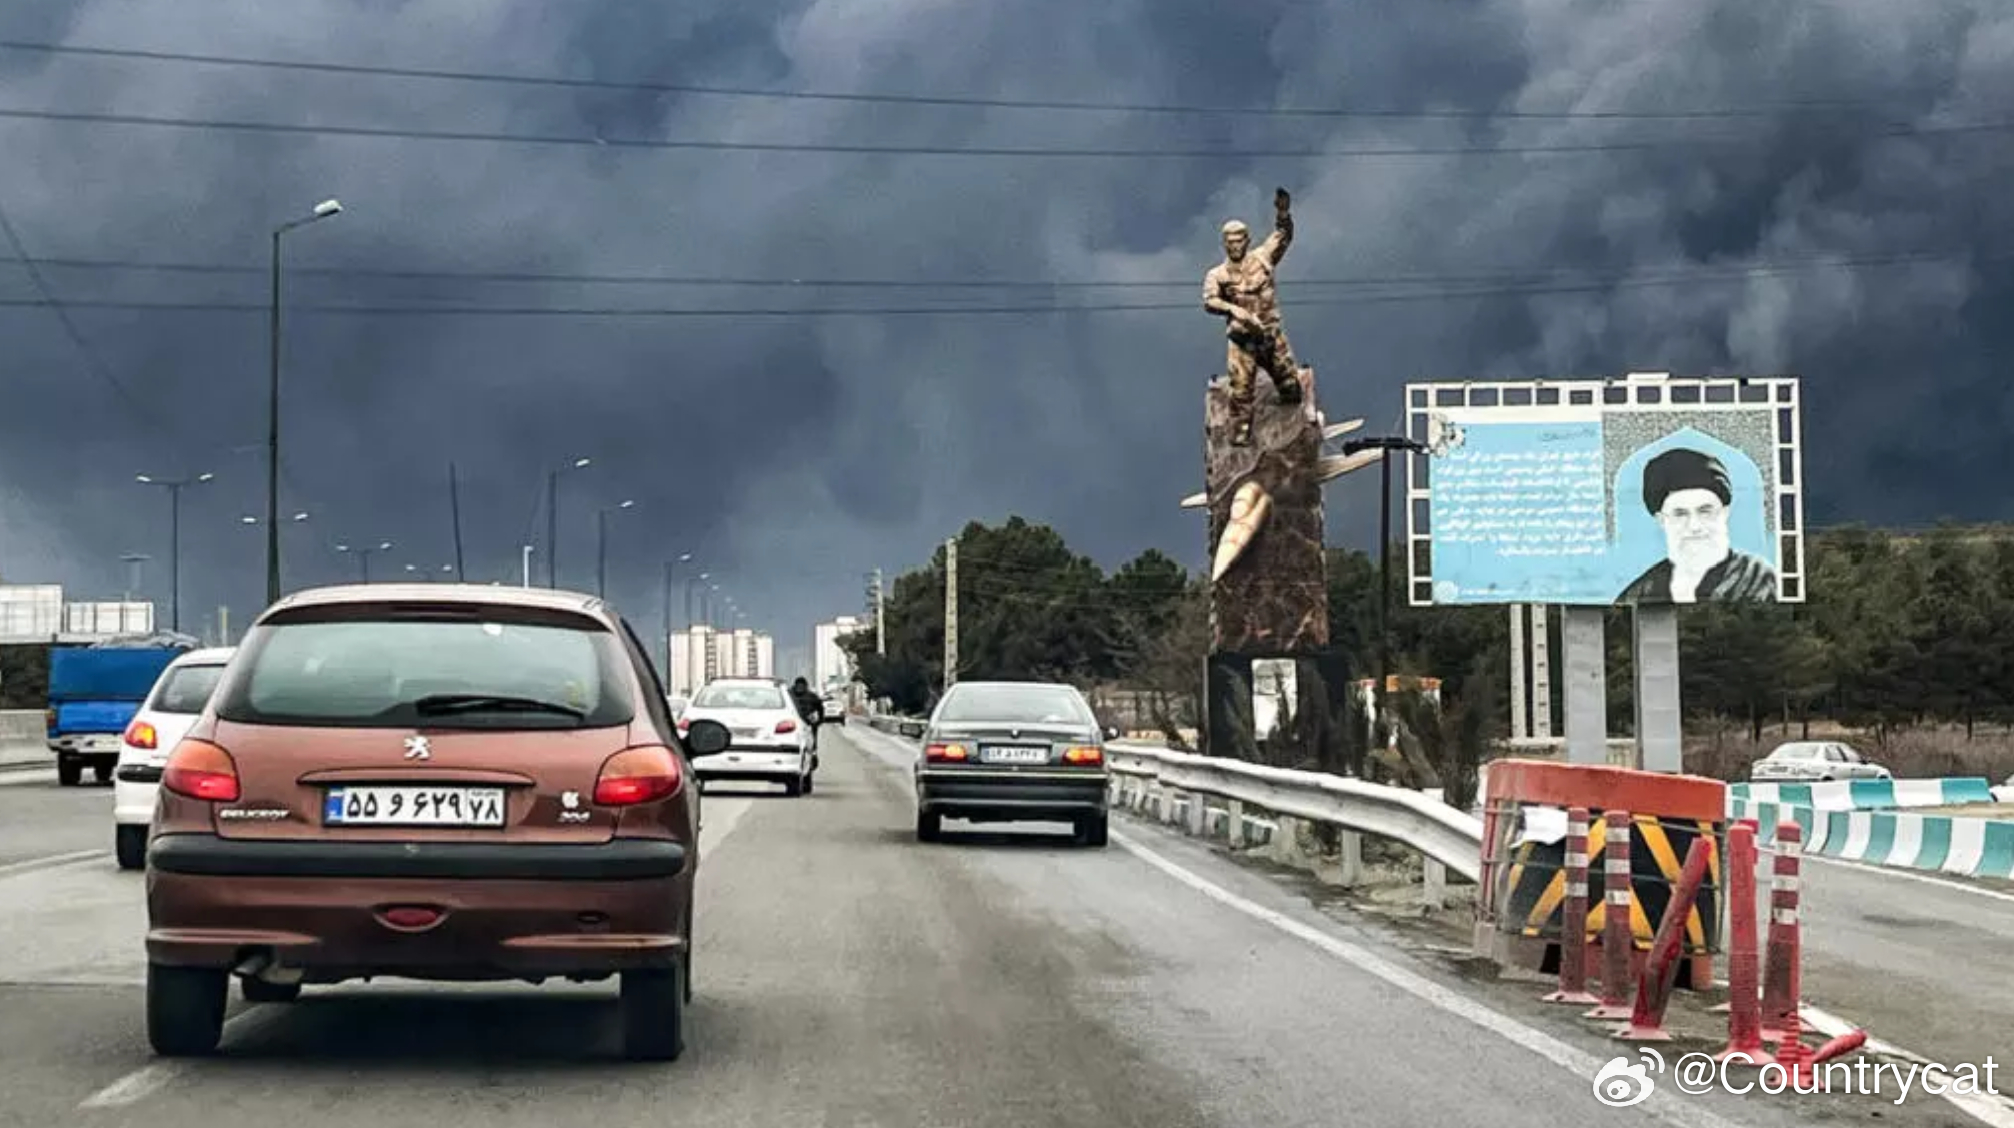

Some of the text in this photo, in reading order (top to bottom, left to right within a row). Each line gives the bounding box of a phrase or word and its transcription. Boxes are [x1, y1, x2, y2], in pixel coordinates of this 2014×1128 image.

[347, 791, 378, 818] ۵۵
[388, 792, 404, 818] و
[412, 792, 463, 819] ۶۲۹
[468, 799, 500, 821] ۷۸
